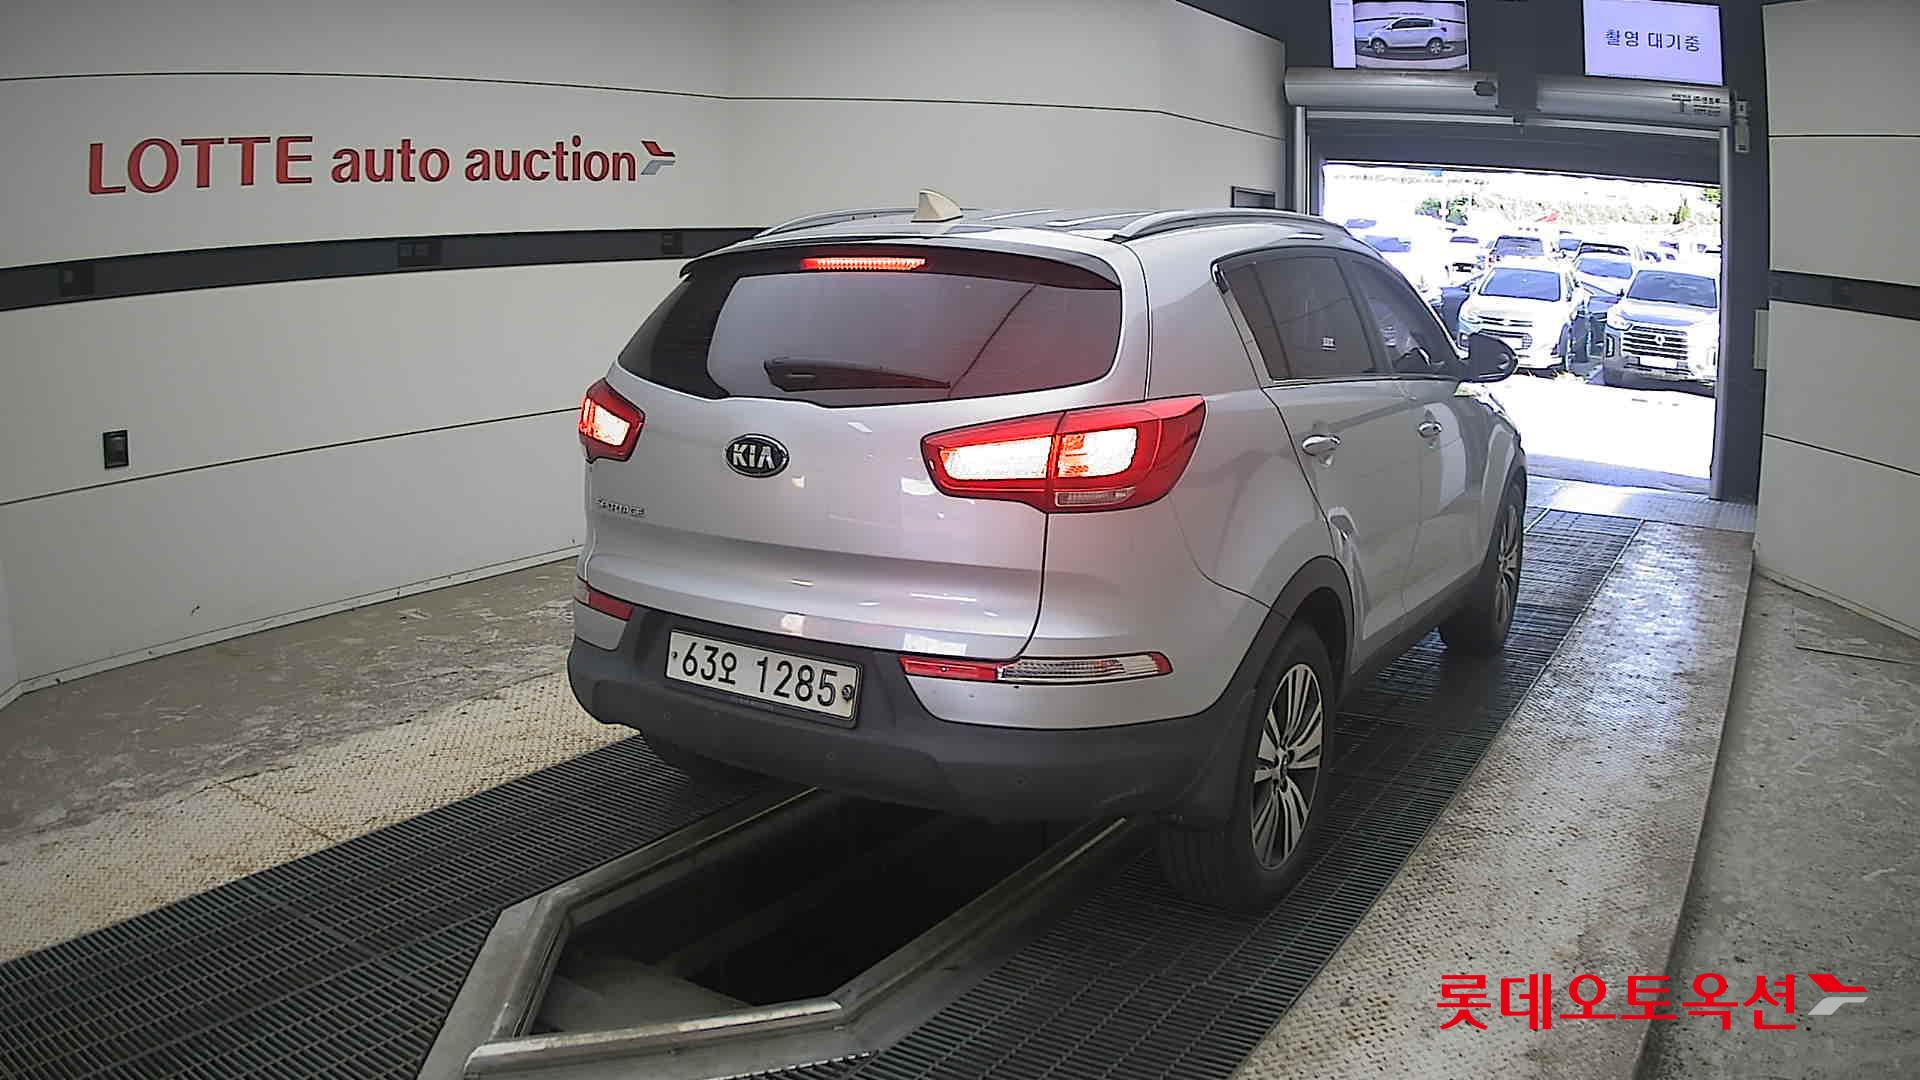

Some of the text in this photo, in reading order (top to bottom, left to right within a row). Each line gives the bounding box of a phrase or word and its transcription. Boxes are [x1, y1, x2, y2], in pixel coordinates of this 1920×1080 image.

[1647, 32, 1700, 52] 대기중
[89, 136, 638, 194] LOTTE auto auction
[733, 443, 775, 469] KIA
[682, 642, 838, 706] 63오 1285
